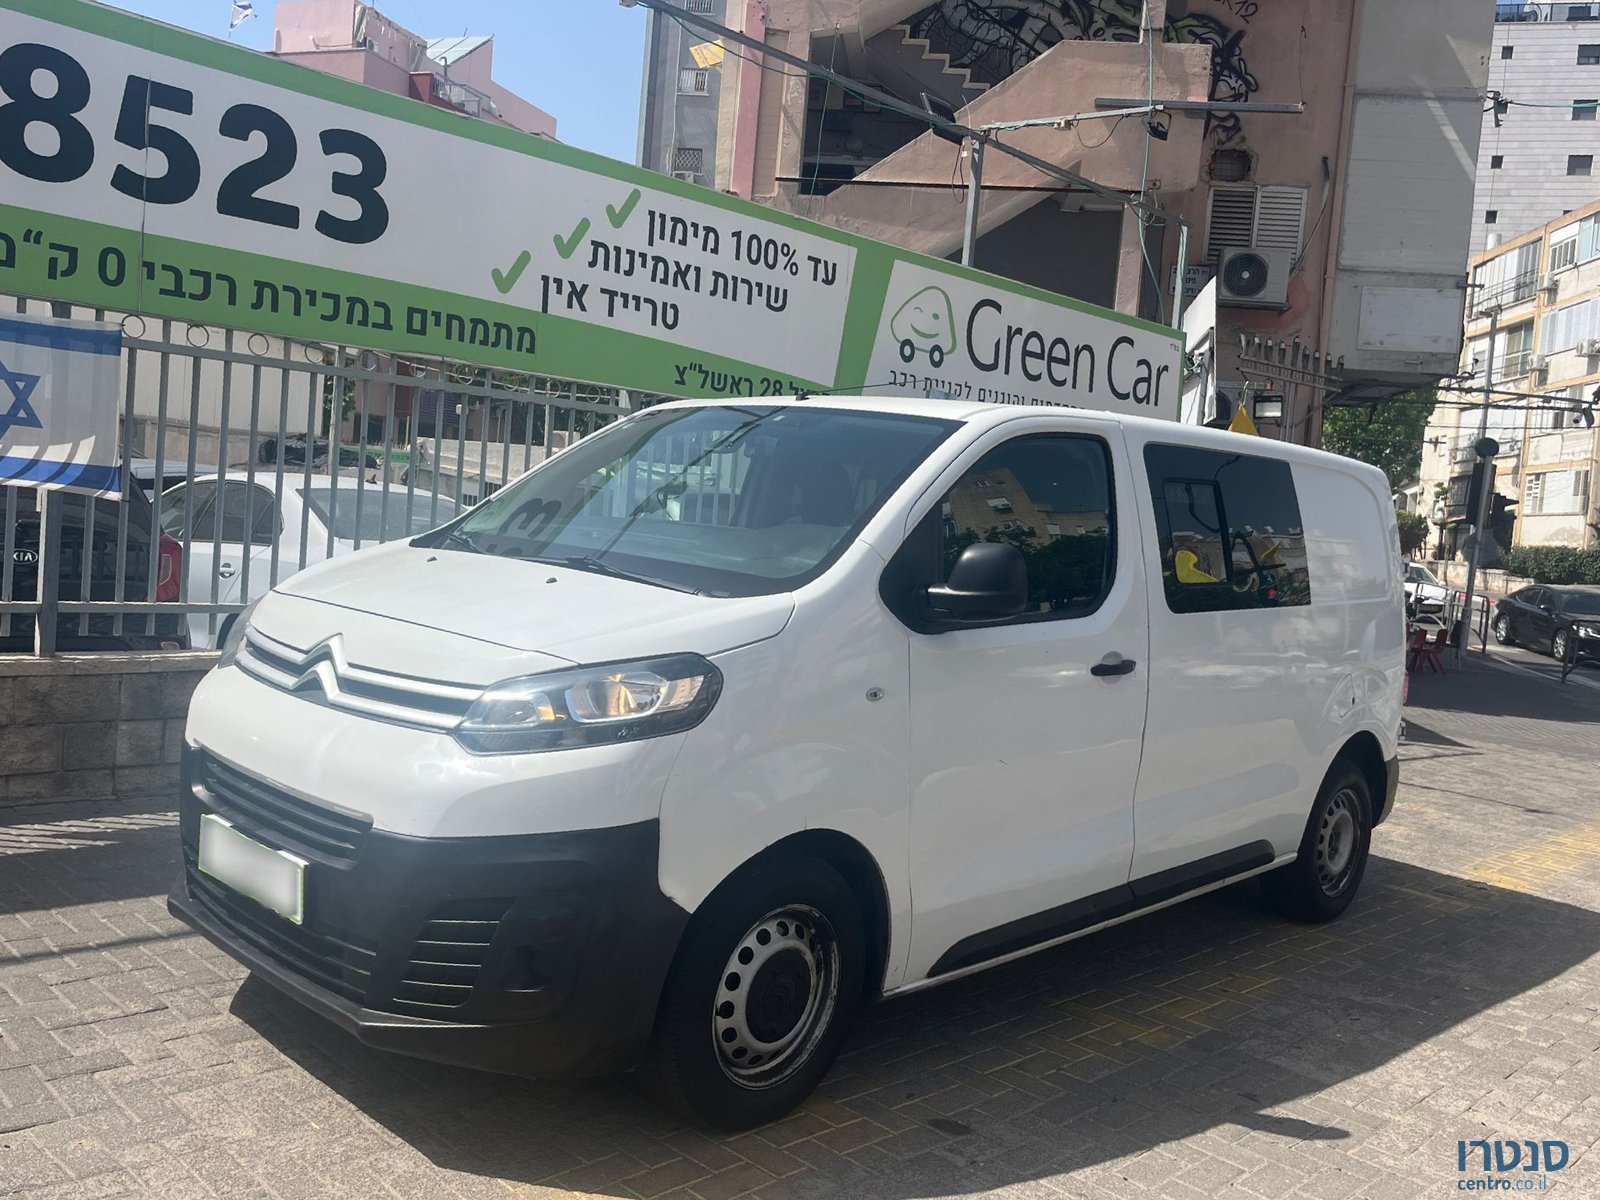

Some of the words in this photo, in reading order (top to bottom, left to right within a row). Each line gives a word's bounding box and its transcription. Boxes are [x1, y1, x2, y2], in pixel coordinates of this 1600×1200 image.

[0, 43, 389, 245] 8523
[647, 209, 720, 255] מימון
[731, 230, 799, 277] 100%
[98, 246, 126, 287] 0
[142, 260, 237, 306] רכבי
[587, 239, 701, 293] ואמינות
[808, 255, 837, 286] עד
[251, 279, 393, 331] במכירת
[540, 274, 589, 314] אין
[600, 287, 680, 330] טרייד
[710, 270, 788, 312] שירות
[406, 306, 536, 354] מתמחים
[966, 299, 1095, 393] Green
[1107, 335, 1169, 406] Car
[674, 362, 754, 397] ראשל"צ
[888, 370, 916, 389] רכב
